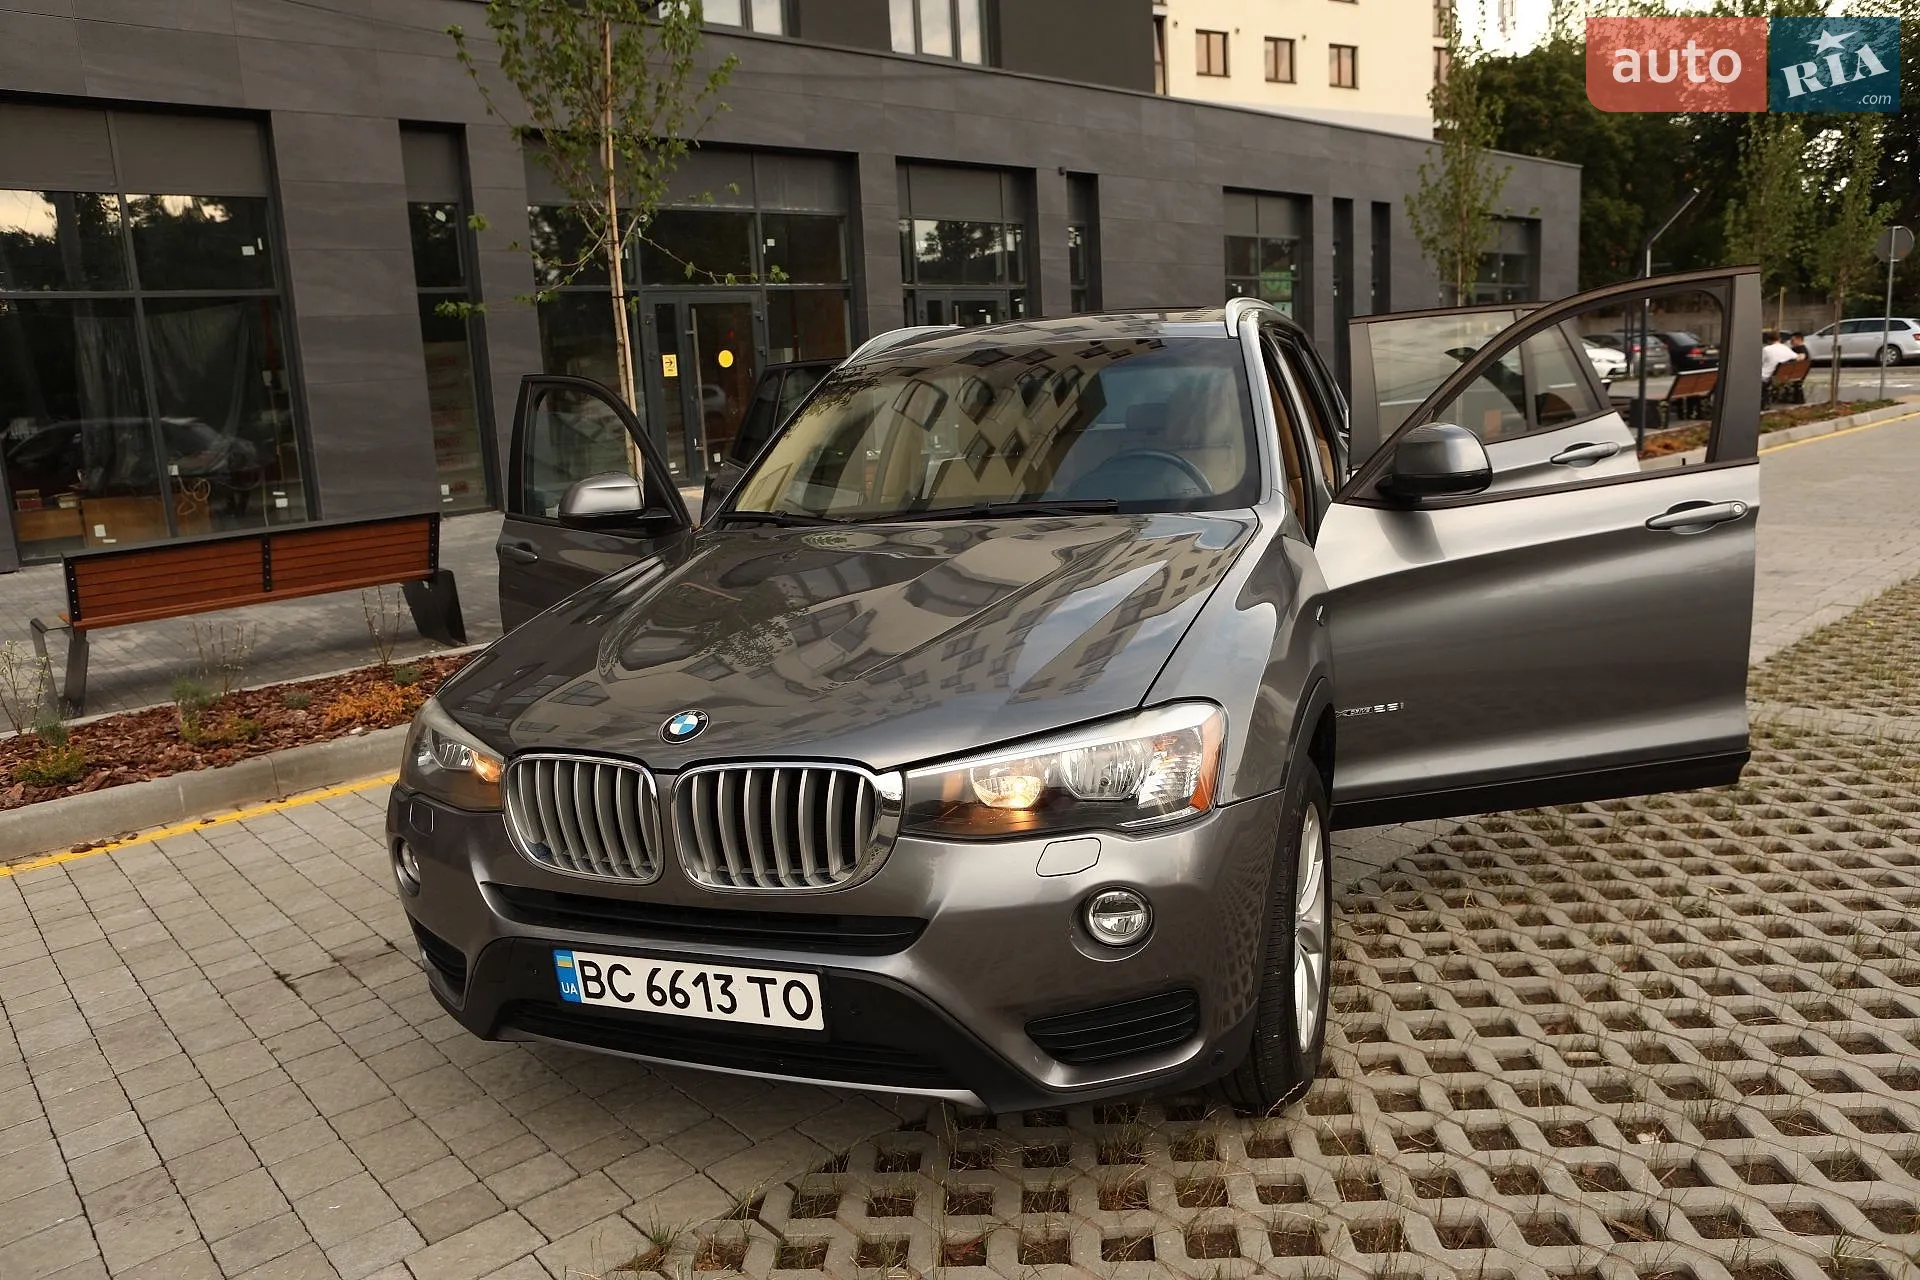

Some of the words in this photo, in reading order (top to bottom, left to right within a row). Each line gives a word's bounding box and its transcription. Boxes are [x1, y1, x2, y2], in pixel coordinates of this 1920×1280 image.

[560, 982, 578, 995] UA
[577, 959, 636, 1003] BC
[646, 967, 738, 1015] 6613
[746, 975, 814, 1021] TO
